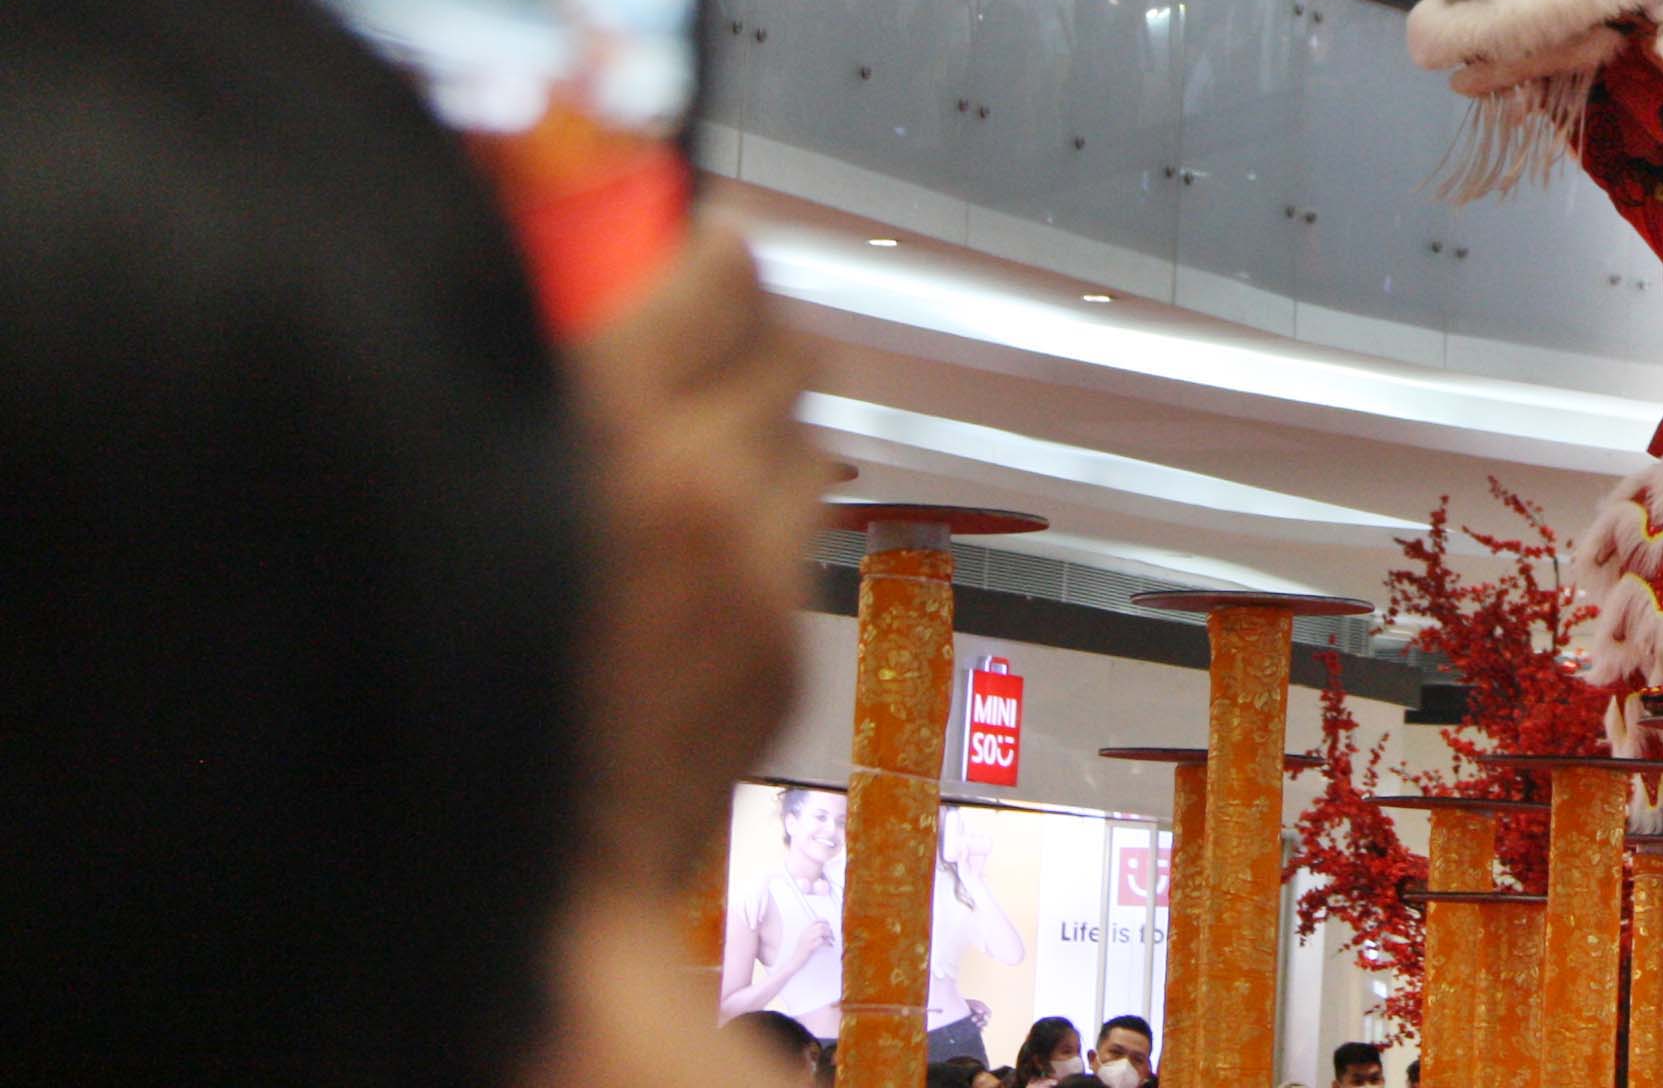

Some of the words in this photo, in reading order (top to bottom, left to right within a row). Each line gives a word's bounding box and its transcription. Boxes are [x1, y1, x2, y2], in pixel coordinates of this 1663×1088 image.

[973, 693, 1018, 729] MINI
[1060, 921, 1101, 944] Life
[1111, 922, 1131, 944] is
